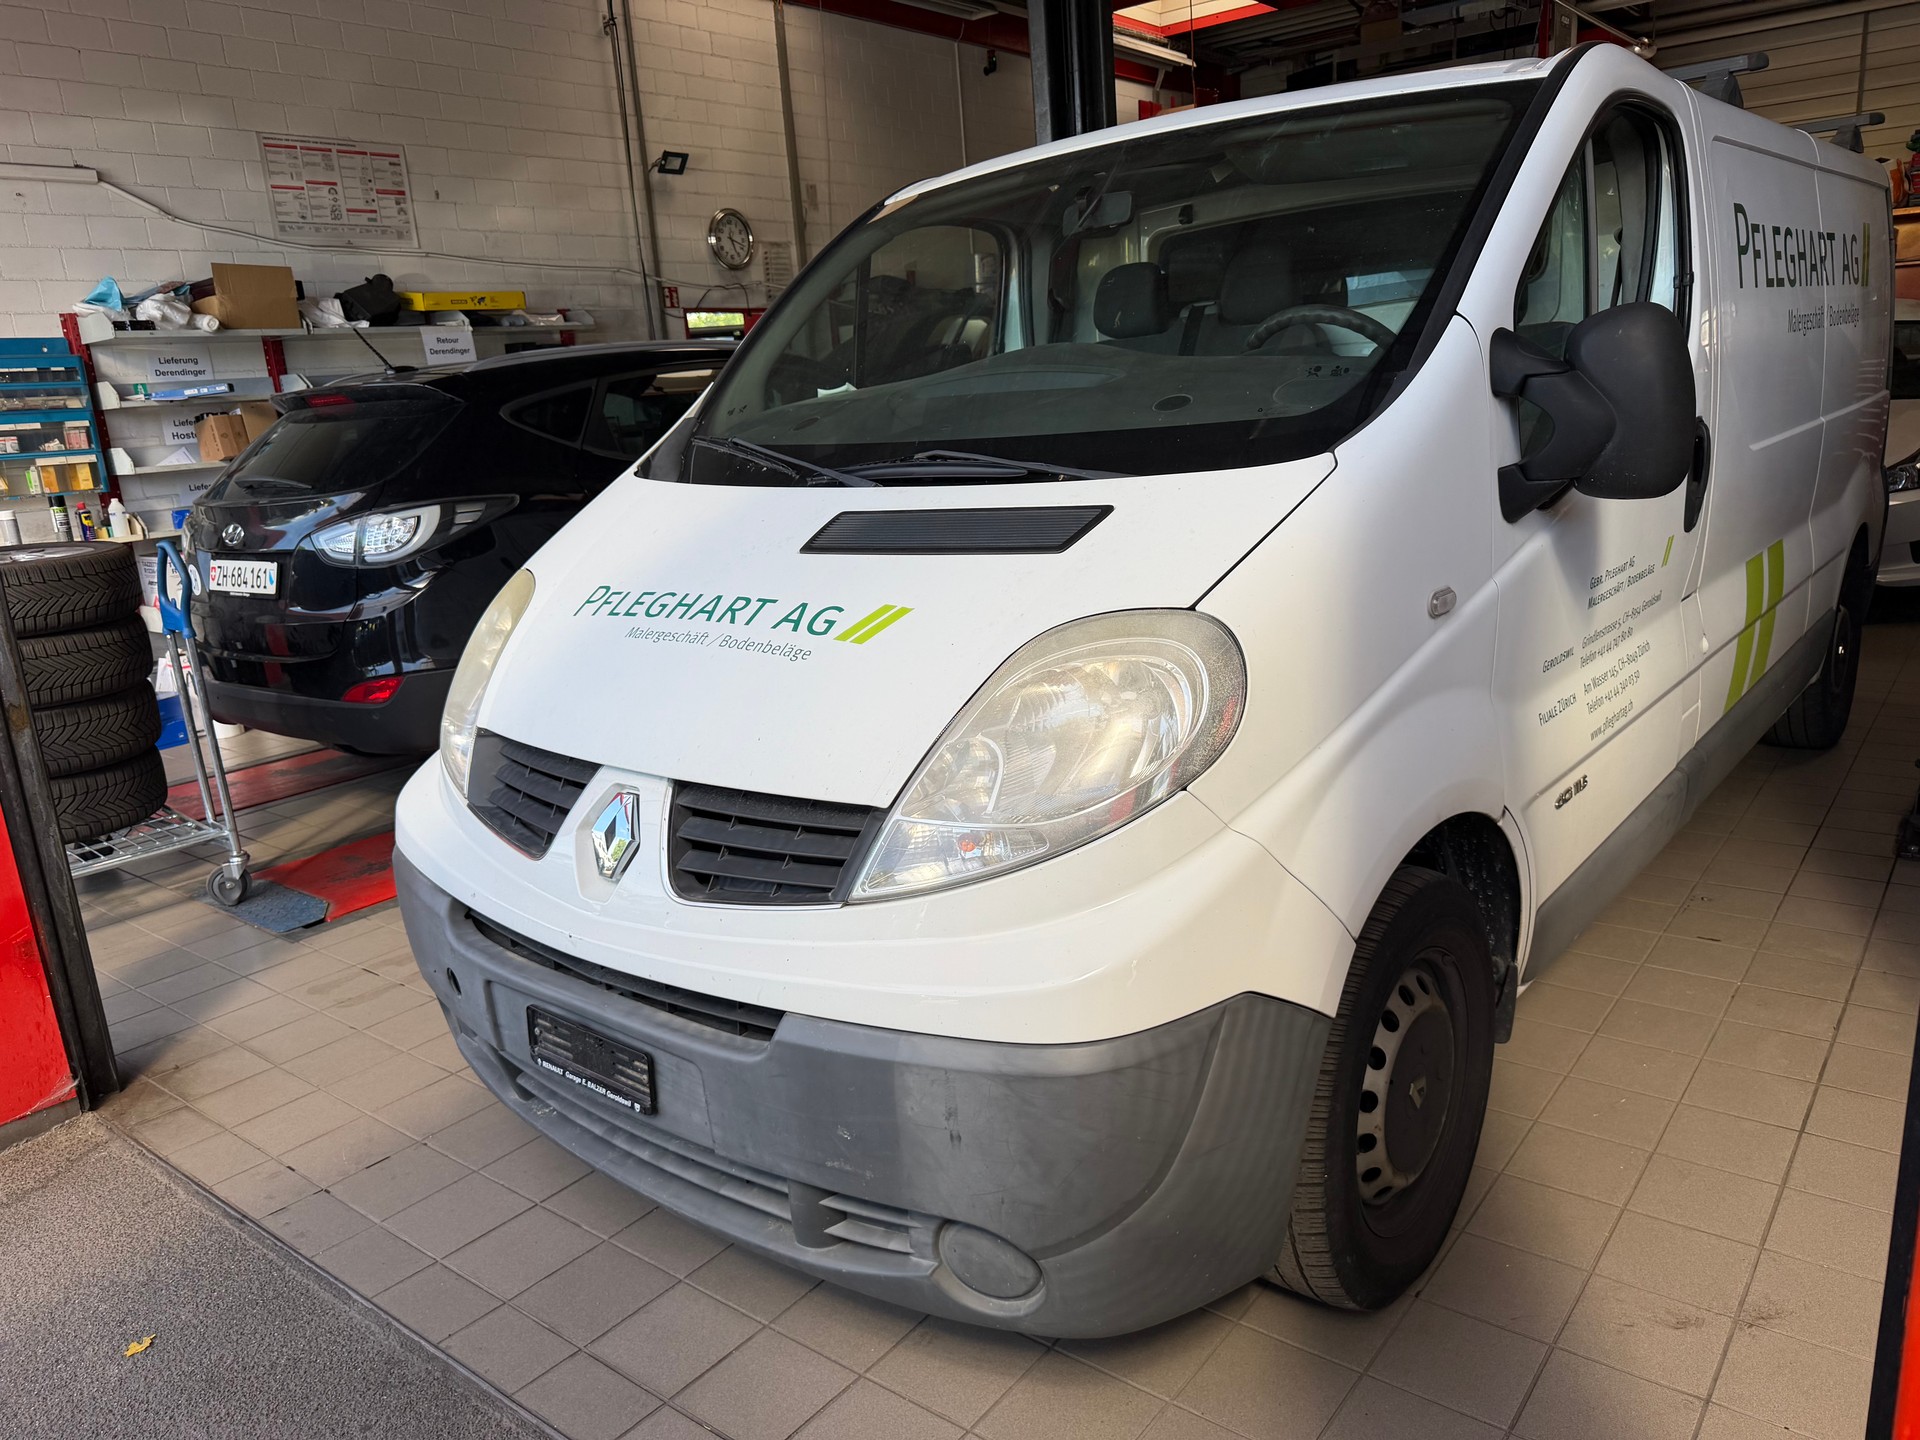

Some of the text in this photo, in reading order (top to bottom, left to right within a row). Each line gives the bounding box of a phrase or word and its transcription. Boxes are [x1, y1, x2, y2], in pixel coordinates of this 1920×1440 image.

[1734, 202, 1860, 289] PFLEGHART AG
[1829, 303, 1860, 328] Bodenbeläge
[430, 347, 470, 356] Derendinger
[437, 337, 459, 345] Retour
[155, 368, 206, 378] Derendinger
[158, 357, 199, 366] Lieferung
[1628, 555, 1635, 569] AG
[573, 585, 845, 636] PFLEGHART AG
[1641, 590, 1662, 612] Geroldswil
[624, 627, 708, 644] Malergeschäft
[719, 635, 812, 662] Bodenbeläge
[1580, 649, 1597, 669] Telefon
[1583, 682, 1592, 696] Am
[1590, 669, 1610, 690] Wasser
[1636, 640, 1651, 658] Zürich
[1586, 695, 1605, 715] Telefon
[1619, 678, 1629, 695] 340
[1590, 699, 1634, 741] www.pfleghartag.ch
[542, 1060, 564, 1075] RENAULT
[565, 1071, 582, 1084] Garage
[587, 1080, 606, 1096] BALZER
